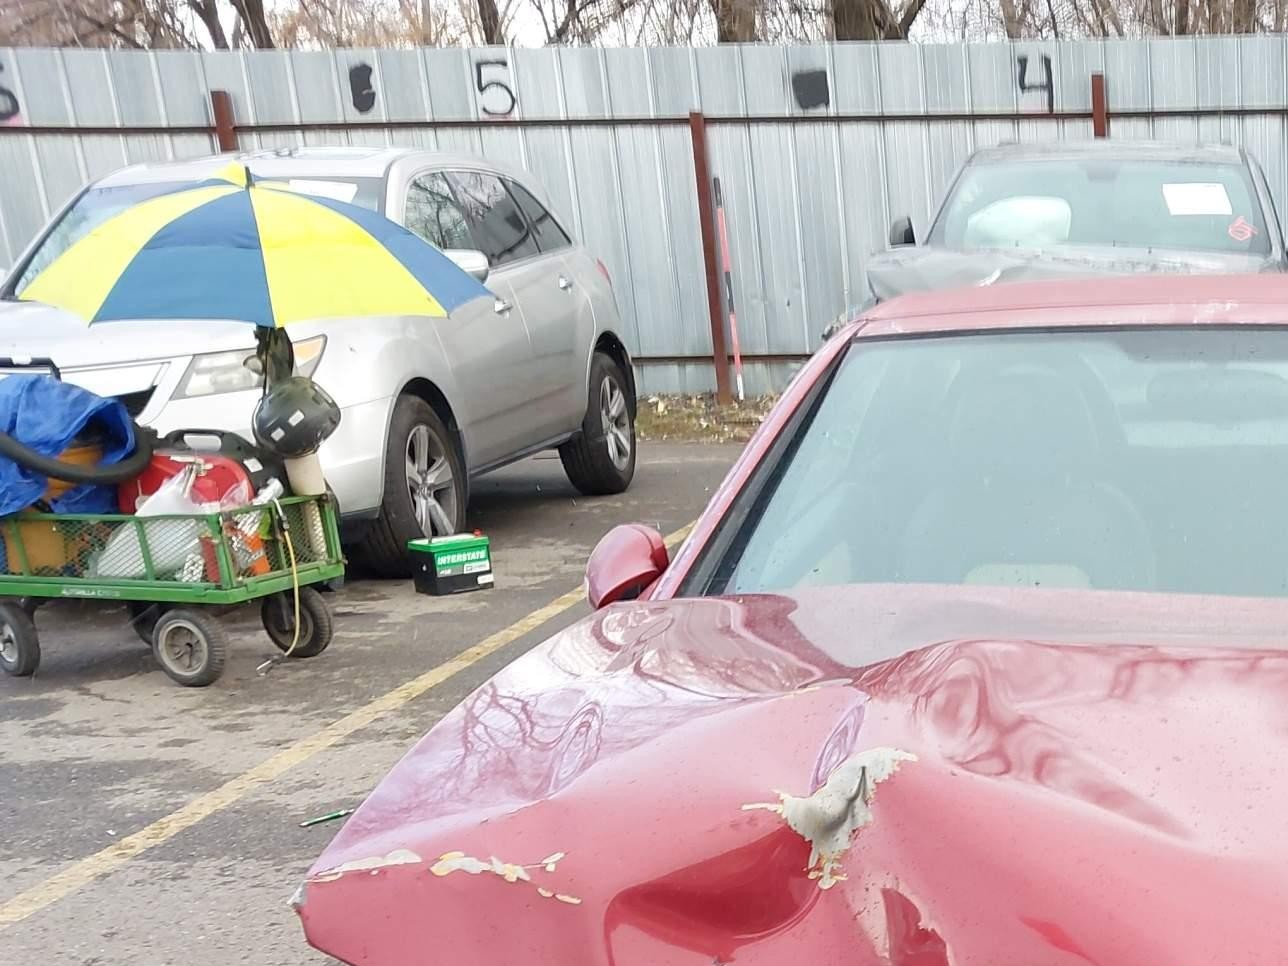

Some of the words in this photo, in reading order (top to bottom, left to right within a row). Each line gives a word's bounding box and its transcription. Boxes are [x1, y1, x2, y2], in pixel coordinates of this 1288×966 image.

[475, 61, 517, 116] 5
[1018, 55, 1054, 112] 4
[437, 549, 486, 565] INTERSTATE
